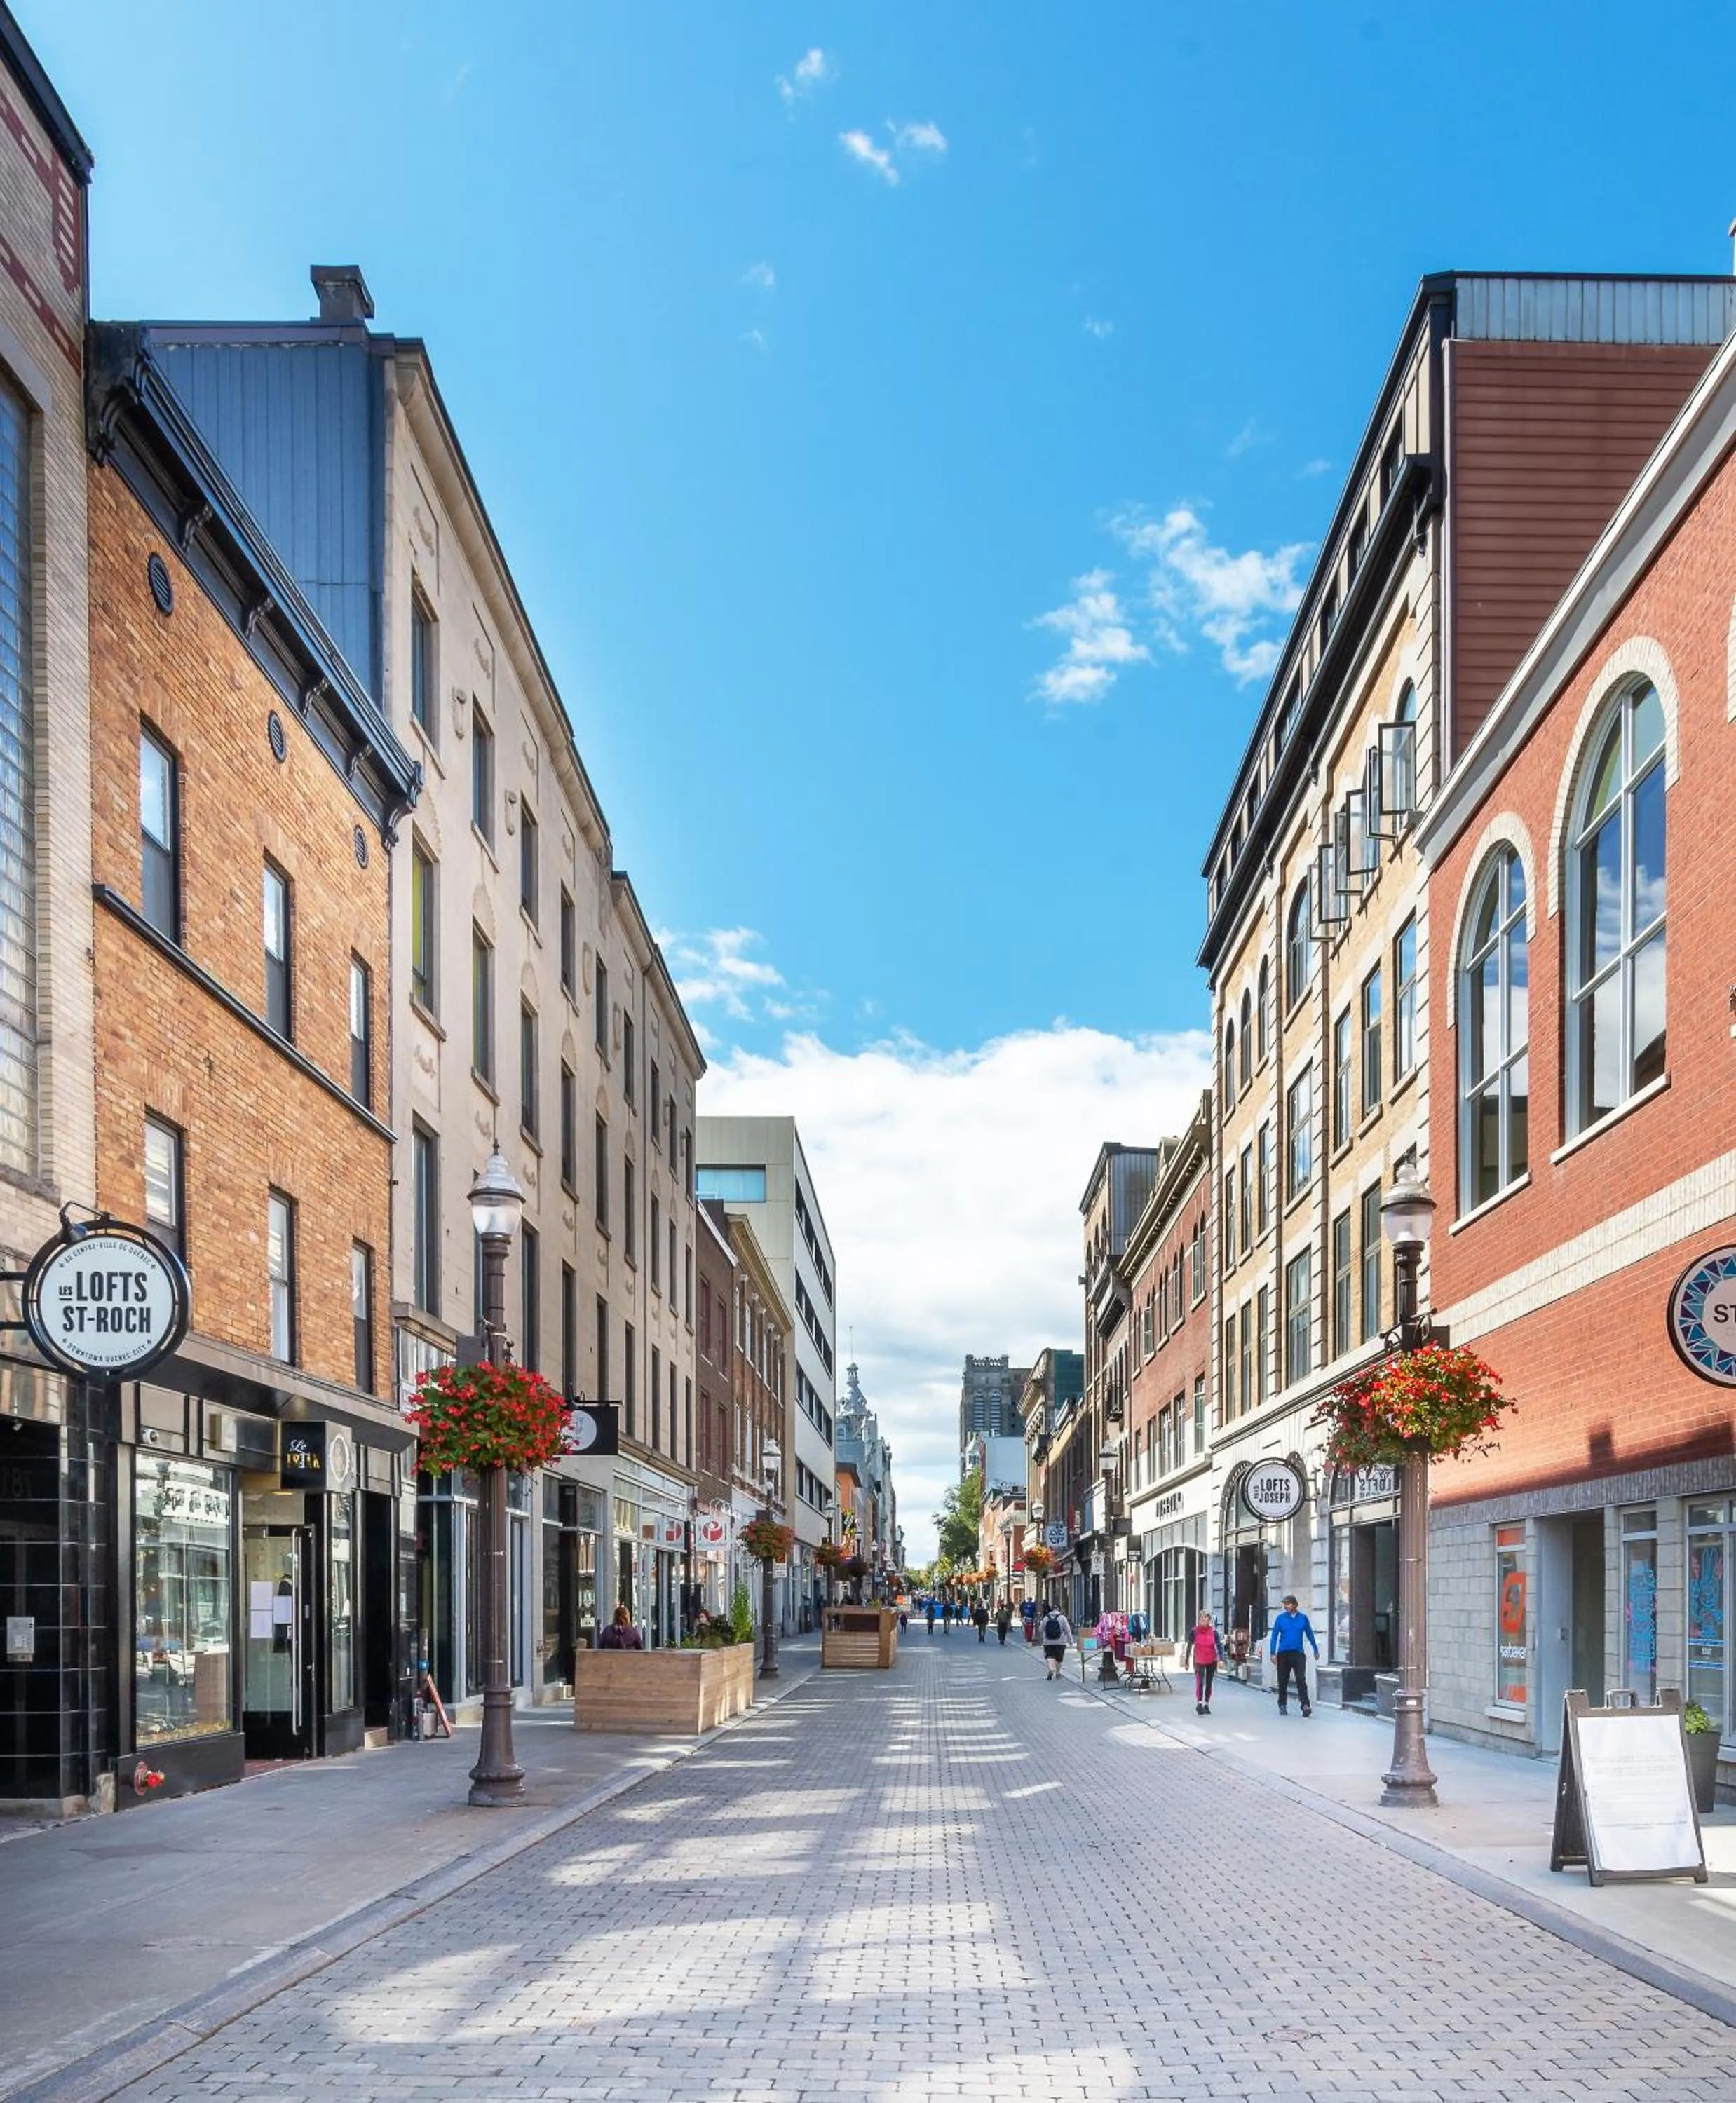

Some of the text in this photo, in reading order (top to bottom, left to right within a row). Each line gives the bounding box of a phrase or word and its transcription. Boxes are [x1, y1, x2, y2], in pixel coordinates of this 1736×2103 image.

[59, 1271, 147, 1302] LES LOFTS
[62, 1306, 151, 1333] ST-ROCH
[1260, 1478, 1291, 1492] LOFTS
[1259, 1492, 1291, 1504] JOSEPH
